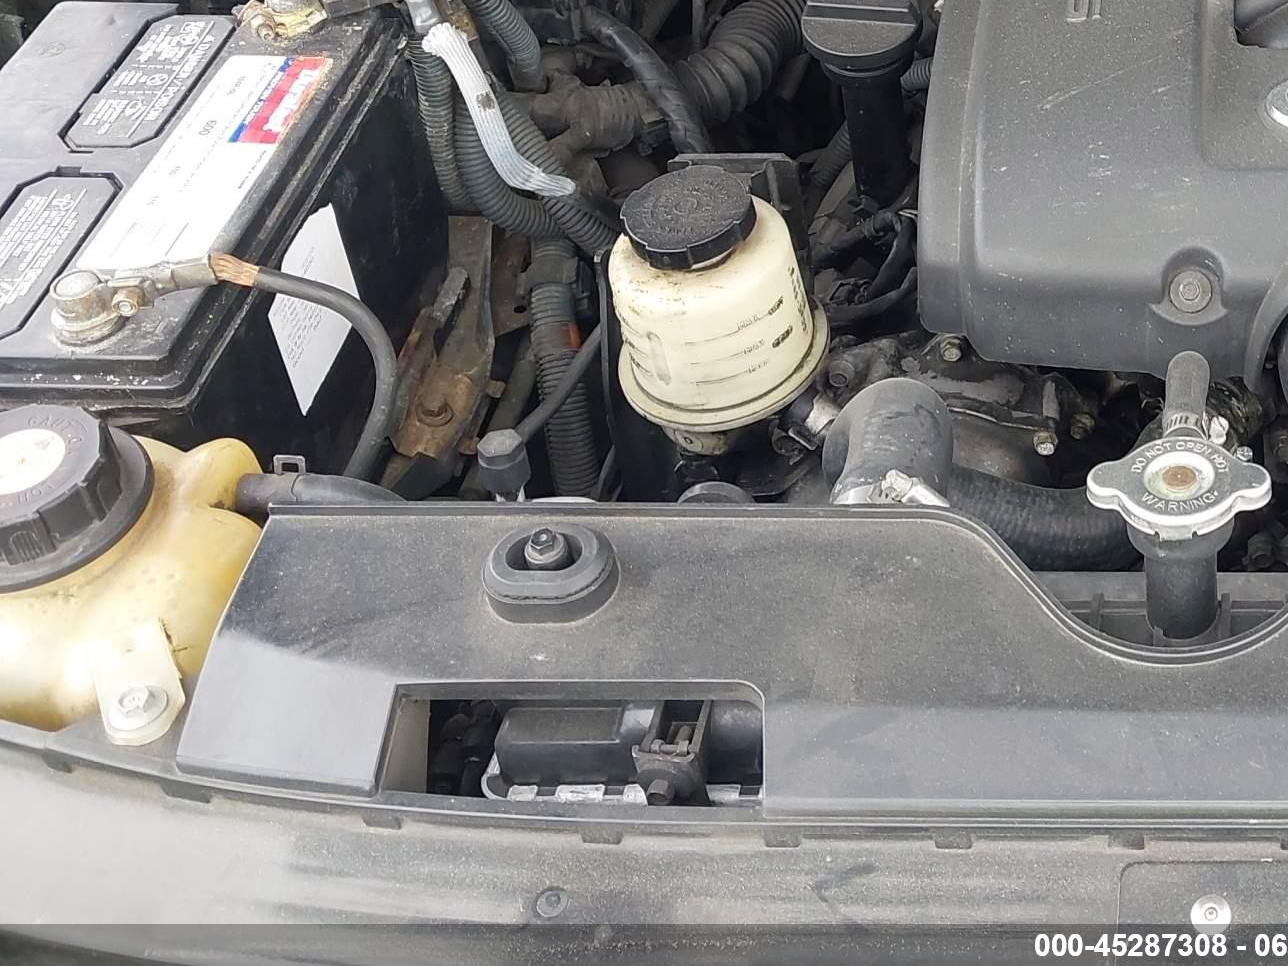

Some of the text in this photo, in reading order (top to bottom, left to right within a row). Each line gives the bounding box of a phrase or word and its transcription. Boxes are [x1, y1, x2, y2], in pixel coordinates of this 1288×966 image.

[198, 119, 218, 136] 600
[1131, 441, 1230, 474] DO NOT OPEN HOT
